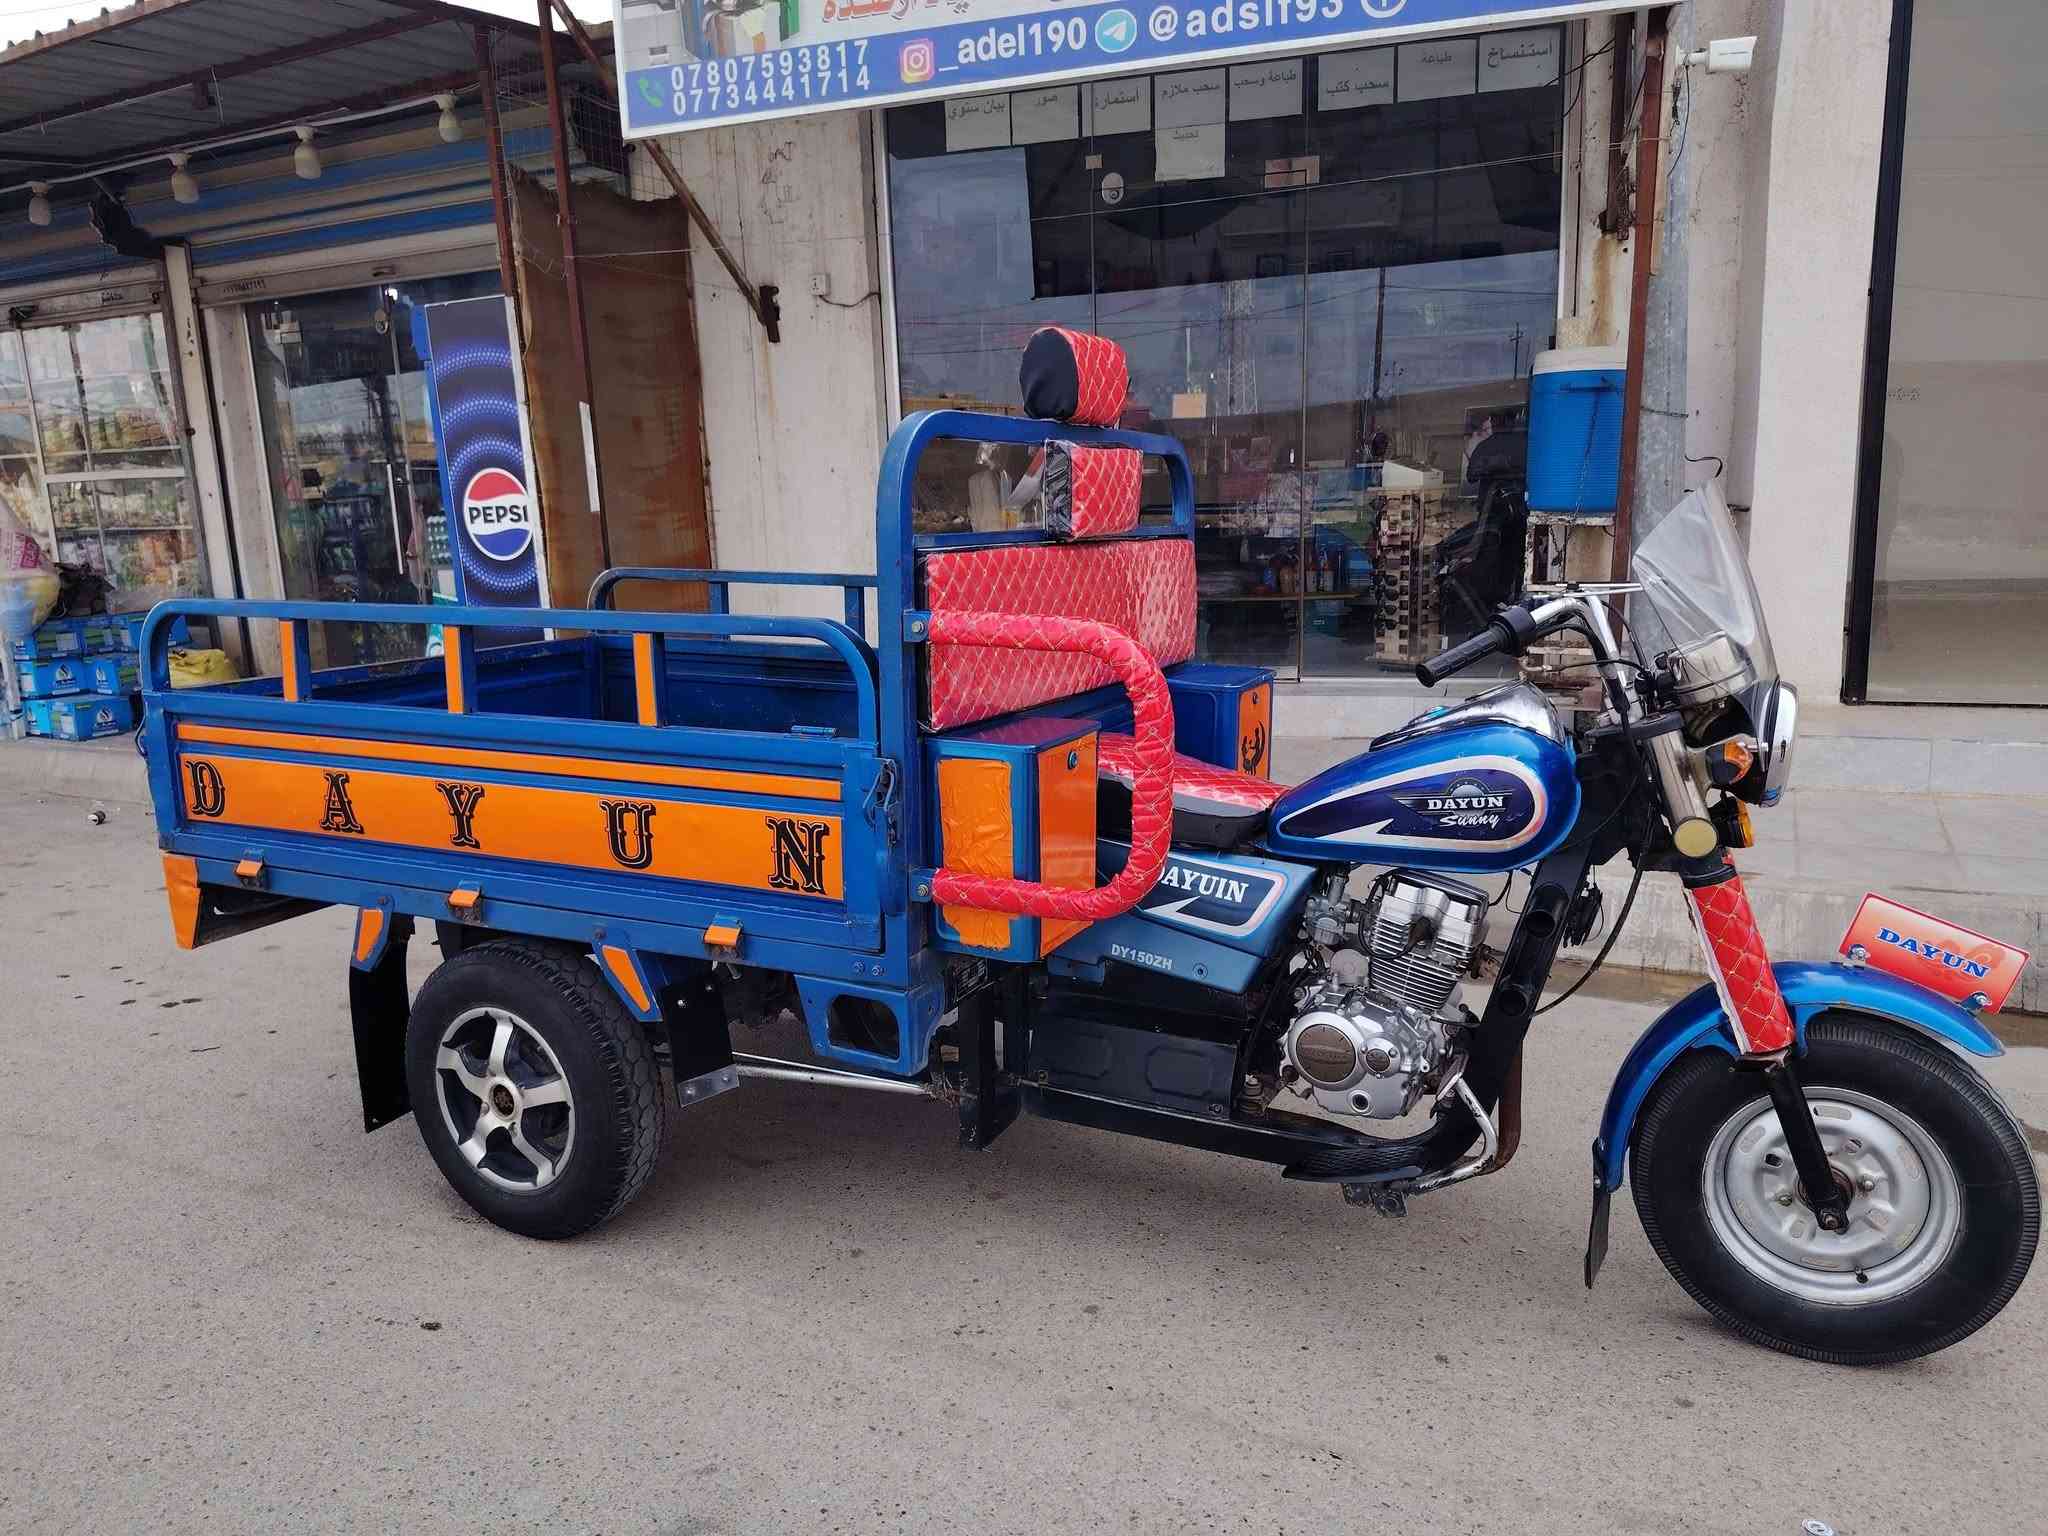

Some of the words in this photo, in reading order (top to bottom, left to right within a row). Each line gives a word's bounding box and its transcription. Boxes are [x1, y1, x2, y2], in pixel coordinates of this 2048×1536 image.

[671, 39, 869, 91] 07807593817
[938, 16, 1087, 73] _adel190
[673, 65, 871, 116] 07734441714
[468, 504, 529, 525] PEPSI
[1427, 796, 1504, 810] DAYUN
[1439, 814, 1501, 830] Sunny
[184, 760, 830, 896] DAYUN
[1157, 865, 1249, 904] AYUIN
[1110, 942, 1174, 971] DY150ZH
[1876, 927, 1992, 979] DAYUN
